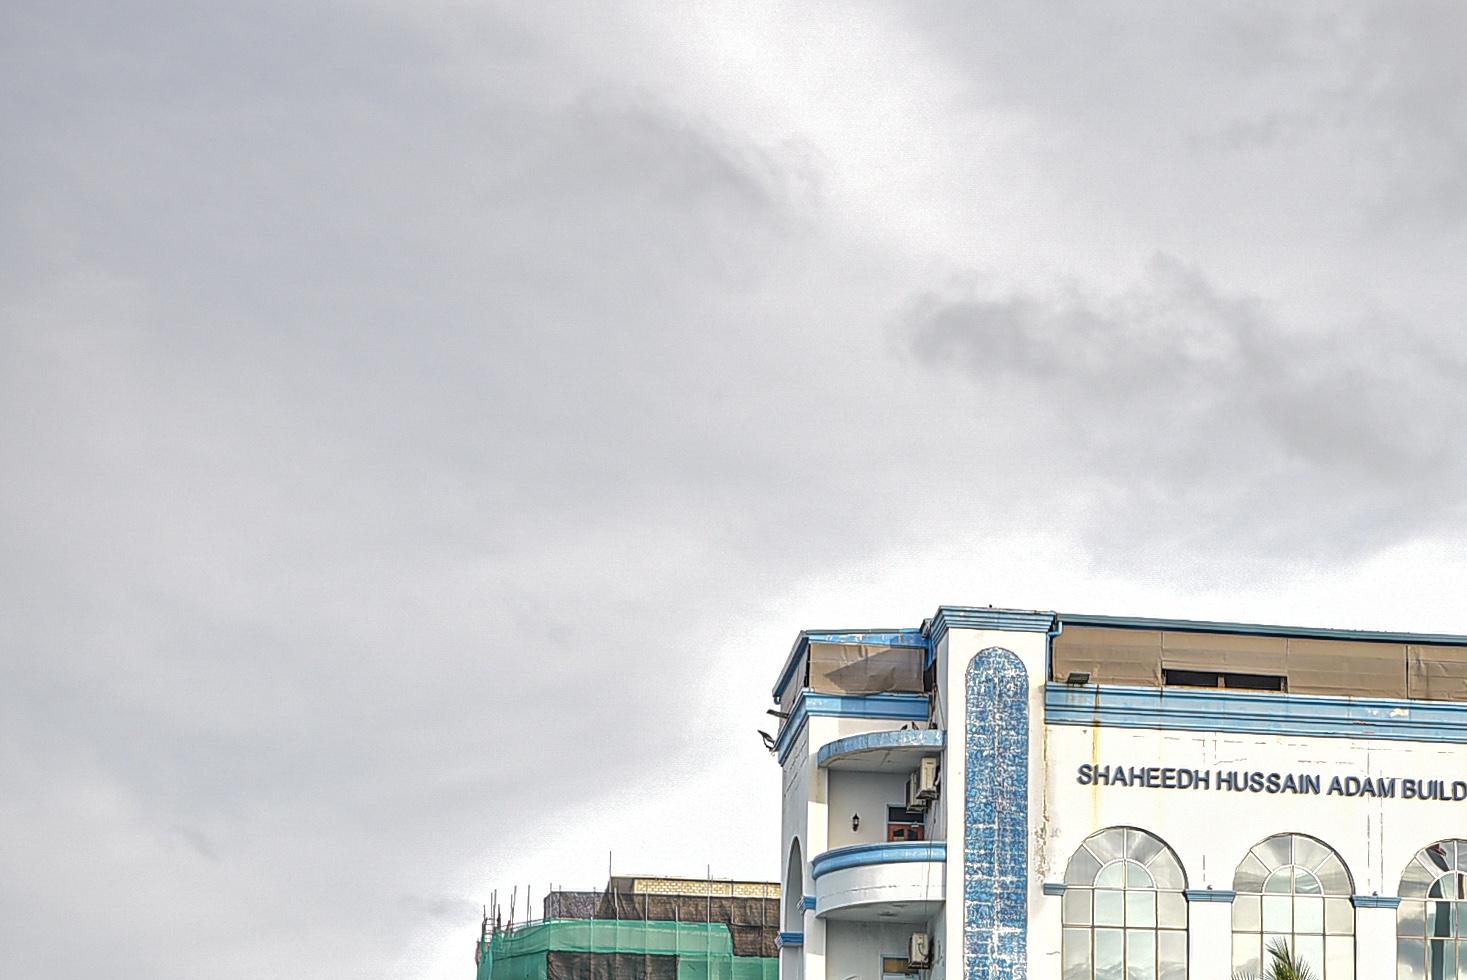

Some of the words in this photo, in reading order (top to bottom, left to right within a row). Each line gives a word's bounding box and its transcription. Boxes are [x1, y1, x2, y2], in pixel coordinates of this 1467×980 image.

[1076, 763, 1210, 790] SHAHEEDH
[1215, 770, 1321, 795] HUSSAIN
[1326, 775, 1396, 799] ADAM
